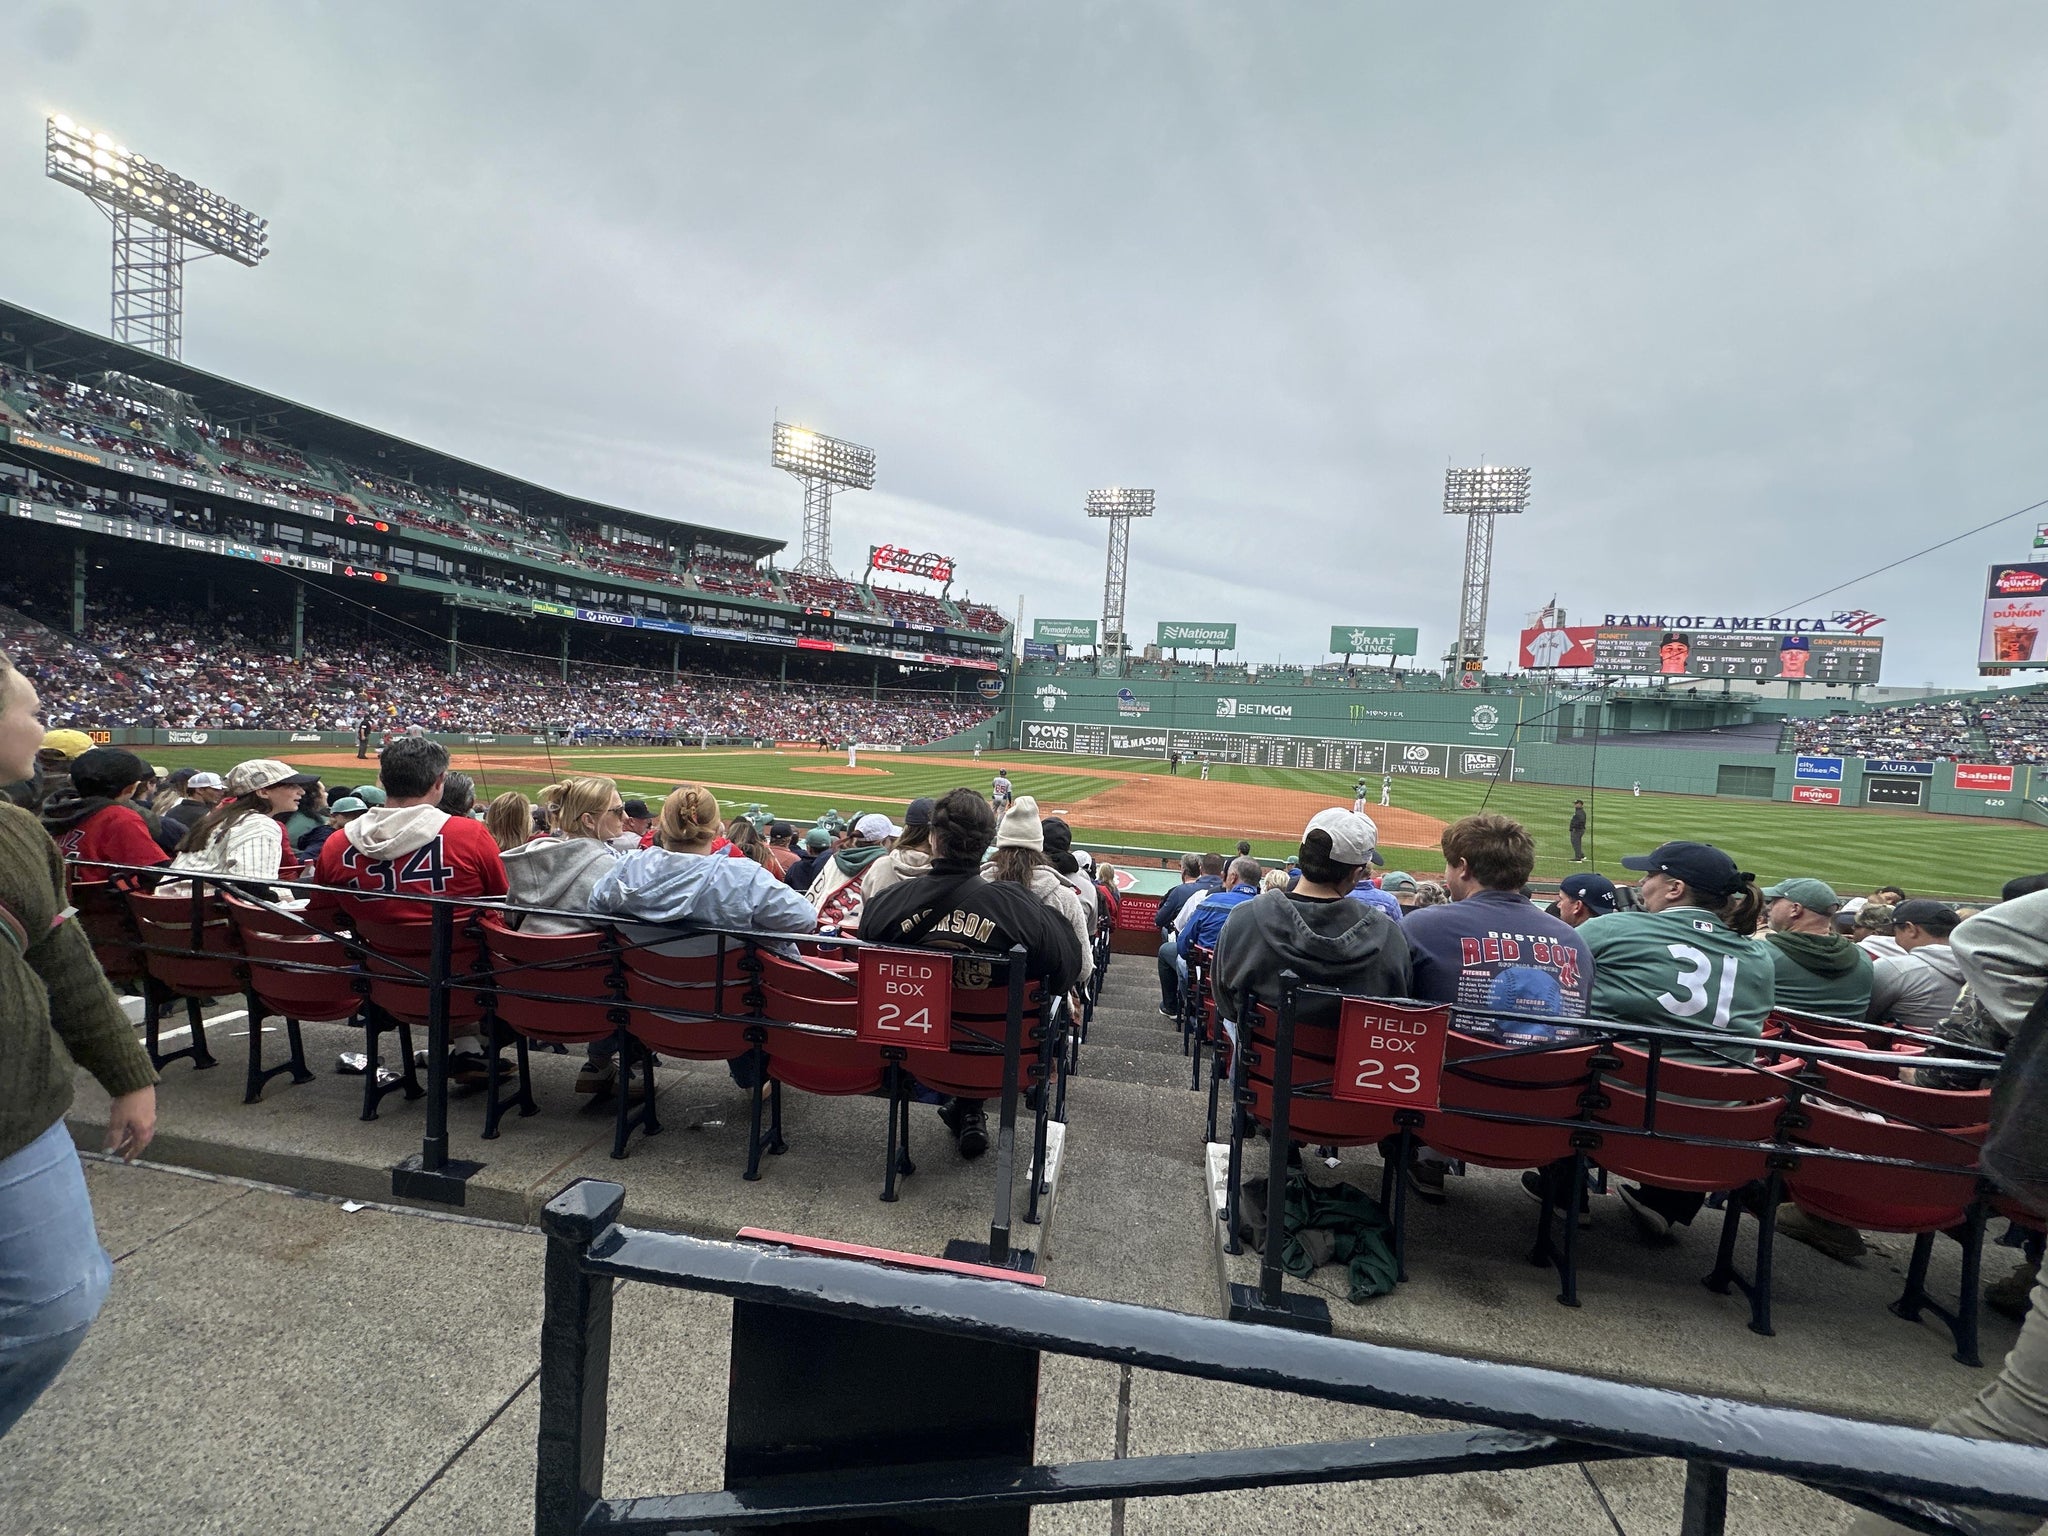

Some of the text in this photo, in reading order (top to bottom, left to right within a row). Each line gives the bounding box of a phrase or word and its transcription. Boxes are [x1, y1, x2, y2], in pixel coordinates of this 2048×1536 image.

[17, 437, 101, 464] CROW-ARMSTRONG
[119, 463, 134, 472] 159
[179, 478, 198, 487] .279
[19, 502, 32, 510] 25
[19, 510, 32, 518] 64
[55, 510, 83, 520] CHICAGO
[56, 518, 82, 528] BOSTON
[187, 538, 206, 548] MVR
[233, 543, 251, 552] BALL
[261, 549, 284, 558] STRIKE
[311, 560, 328, 571] 5TH
[1993, 609, 2046, 618] DUNKIN'
[598, 614, 623, 624] HYCU
[1604, 614, 1827, 632] BANK OF AMERICA
[911, 624, 935, 632] UNITED
[1039, 625, 1091, 635] Plymouth Rock
[1178, 627, 1230, 640] National
[754, 636, 781, 644] VINEYARD
[1350, 636, 1396, 646] DRAFT
[1813, 638, 1882, 646] CROW-ARMSTRONG
[1355, 644, 1394, 653] KINGS
[1701, 663, 1709, 673] 3
[1727, 664, 1736, 674] 2
[1754, 665, 1762, 675] 0
[978, 681, 1003, 690] Gulf
[1561, 694, 1601, 702] ABIOMED
[1238, 704, 1292, 716] BETMGM
[1366, 710, 1404, 718] MONSTER
[168, 730, 192, 738] Ninety
[1041, 726, 1069, 738] CVS
[168, 735, 192, 743] Nine
[290, 733, 321, 743] Franklin
[1028, 737, 1068, 750] Health
[1467, 753, 1497, 763] ACE
[1390, 764, 1441, 775] F.W. WEBB
[1957, 771, 2011, 780] Safelite
[1799, 791, 1833, 799] IRVING
[1984, 799, 2005, 807] 420
[342, 834, 454, 902] 34
[1488, 931, 1559, 944] BOSTON
[1460, 937, 1582, 978] RED SOX
[878, 963, 933, 979] FIELD
[885, 981, 925, 998] BOX
[1656, 943, 1739, 1028] 31
[876, 1002, 933, 1034] 24
[1363, 1015, 1428, 1036] FIELD
[1370, 1035, 1416, 1054] BOX
[1354, 1057, 1422, 1095] 23
